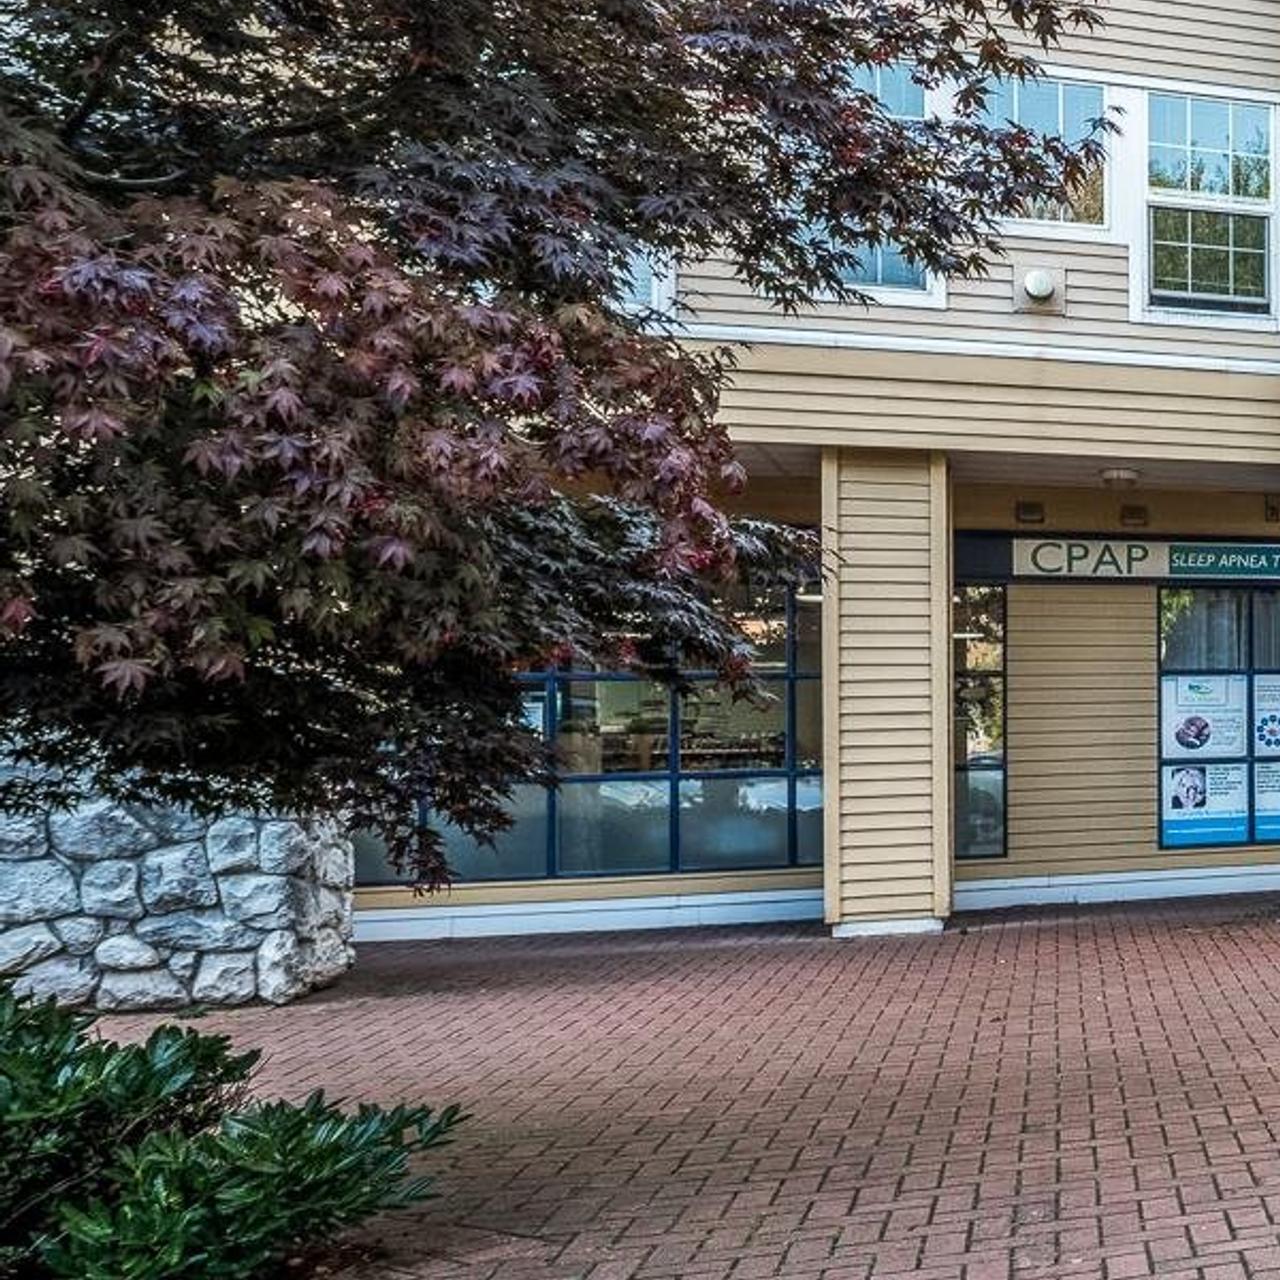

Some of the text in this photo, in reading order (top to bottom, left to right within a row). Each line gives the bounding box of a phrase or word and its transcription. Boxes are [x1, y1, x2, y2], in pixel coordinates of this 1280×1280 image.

[1031, 542, 1149, 574] CPAP
[1171, 552, 1215, 567] SLEEP
[1218, 553, 1268, 569] APNEA
